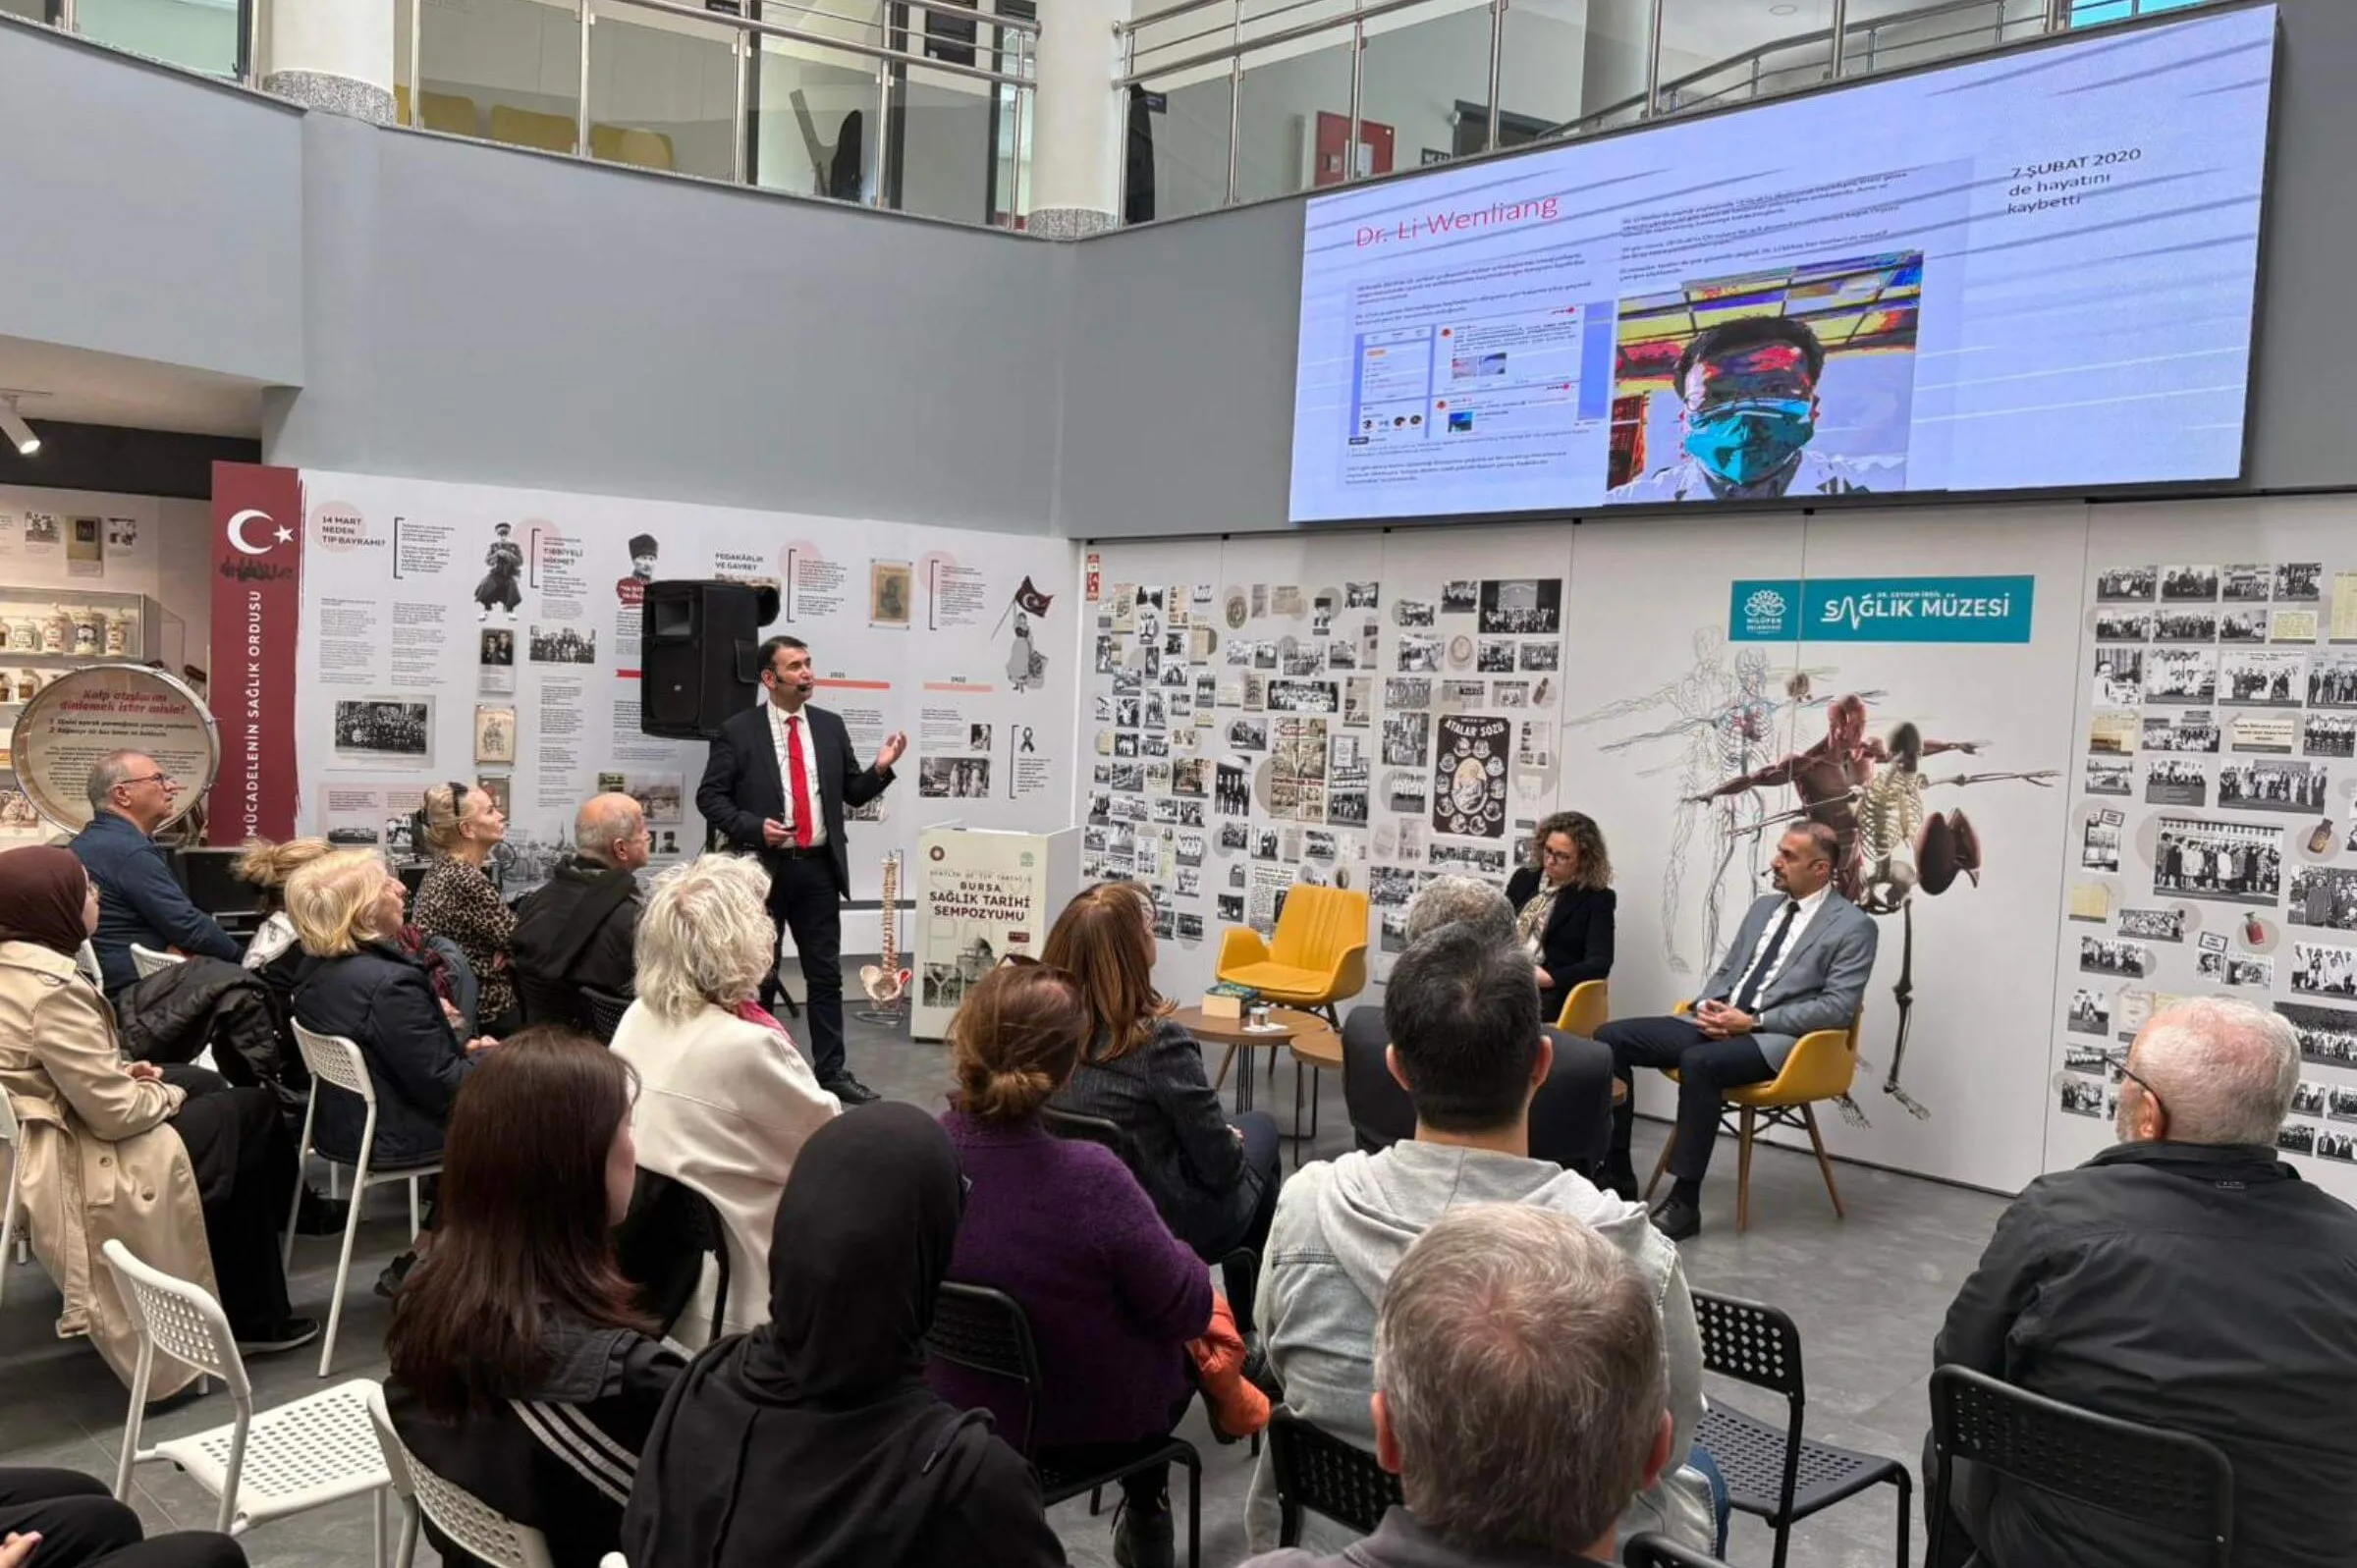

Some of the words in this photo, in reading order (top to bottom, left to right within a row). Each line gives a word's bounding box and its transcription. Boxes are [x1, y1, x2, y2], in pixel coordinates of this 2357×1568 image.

[2011, 168, 2022, 178] 7
[2026, 156, 2089, 179] ŞUBAT
[2093, 147, 2142, 166] 2020
[2008, 184, 2032, 196] de
[2037, 174, 2110, 192] hayatını
[2006, 192, 2081, 215] kaybetti
[1356, 226, 1387, 247] Dr.
[1398, 218, 1417, 240] Li
[1427, 195, 1559, 235] Wenliang
[322, 525, 354, 534] NEDEN
[335, 516, 361, 525] MART
[1820, 593, 1914, 630] SAĞLIK
[1921, 592, 2010, 618] MÜZESİ
[248, 591, 261, 657] ORDUSU
[246, 662, 259, 718] SAĞLIK
[244, 724, 259, 838] MÜCADELENİN
[960, 882, 1001, 892] BURSA
[930, 890, 978, 904] SAĞLIK
[982, 894, 1031, 909] TARİHİ
[934, 905, 1025, 922] SEMPOZYUMU
